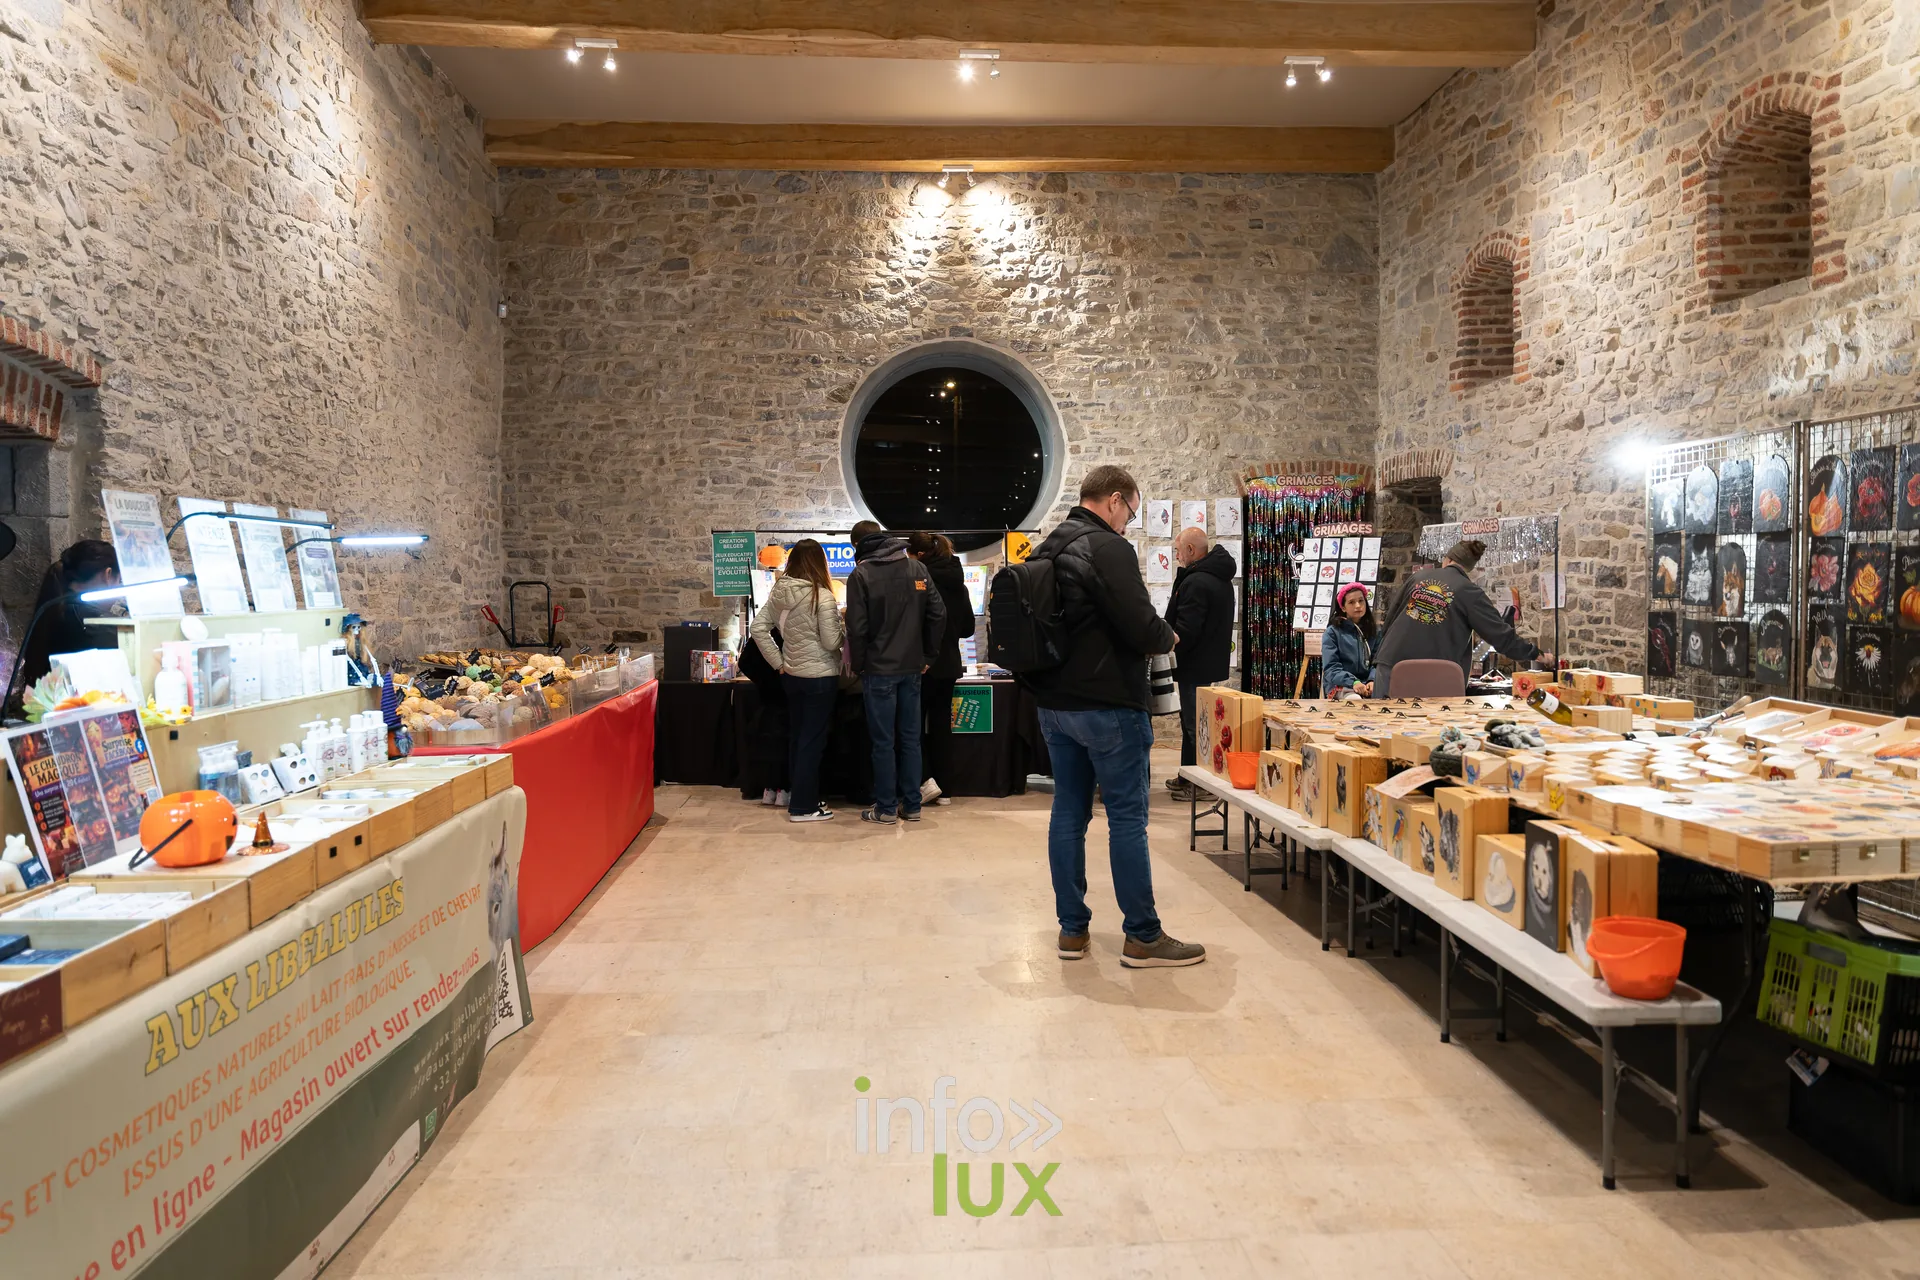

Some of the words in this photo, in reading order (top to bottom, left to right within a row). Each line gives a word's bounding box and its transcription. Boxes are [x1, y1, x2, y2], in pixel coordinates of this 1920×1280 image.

[1277, 475, 1335, 486] GRIMAGES
[1314, 523, 1373, 537] GRIMAGES
[1463, 519, 1499, 535] GRIMAGES
[102, 737, 132, 752] Surprise
[29, 764, 40, 776] LE
[37, 763, 81, 786] MAGQUE
[144, 972, 240, 1077] AUX
[245, 877, 405, 1014] LIBELLULES
[24, 1171, 57, 1217] ET
[63, 1069, 212, 1190] COSMETIQUES
[216, 1013, 292, 1085] NATURELS
[294, 1003, 309, 1029] AU
[311, 977, 343, 1014] LAIT
[343, 955, 375, 994] FRAIS
[418, 914, 431, 936] ET
[432, 906, 449, 928] DE
[123, 1130, 184, 1197] ISSUS
[189, 1086, 244, 1147] D'UNE
[247, 1011, 342, 1102] AGRICULTURE
[344, 959, 417, 1026] BIOLOGIQUE.
[110, 1223, 147, 1272] en
[153, 1163, 216, 1236] ligne
[241, 1076, 321, 1161] Magasin
[324, 1025, 382, 1087] ouvert
[383, 1007, 410, 1041] sur
